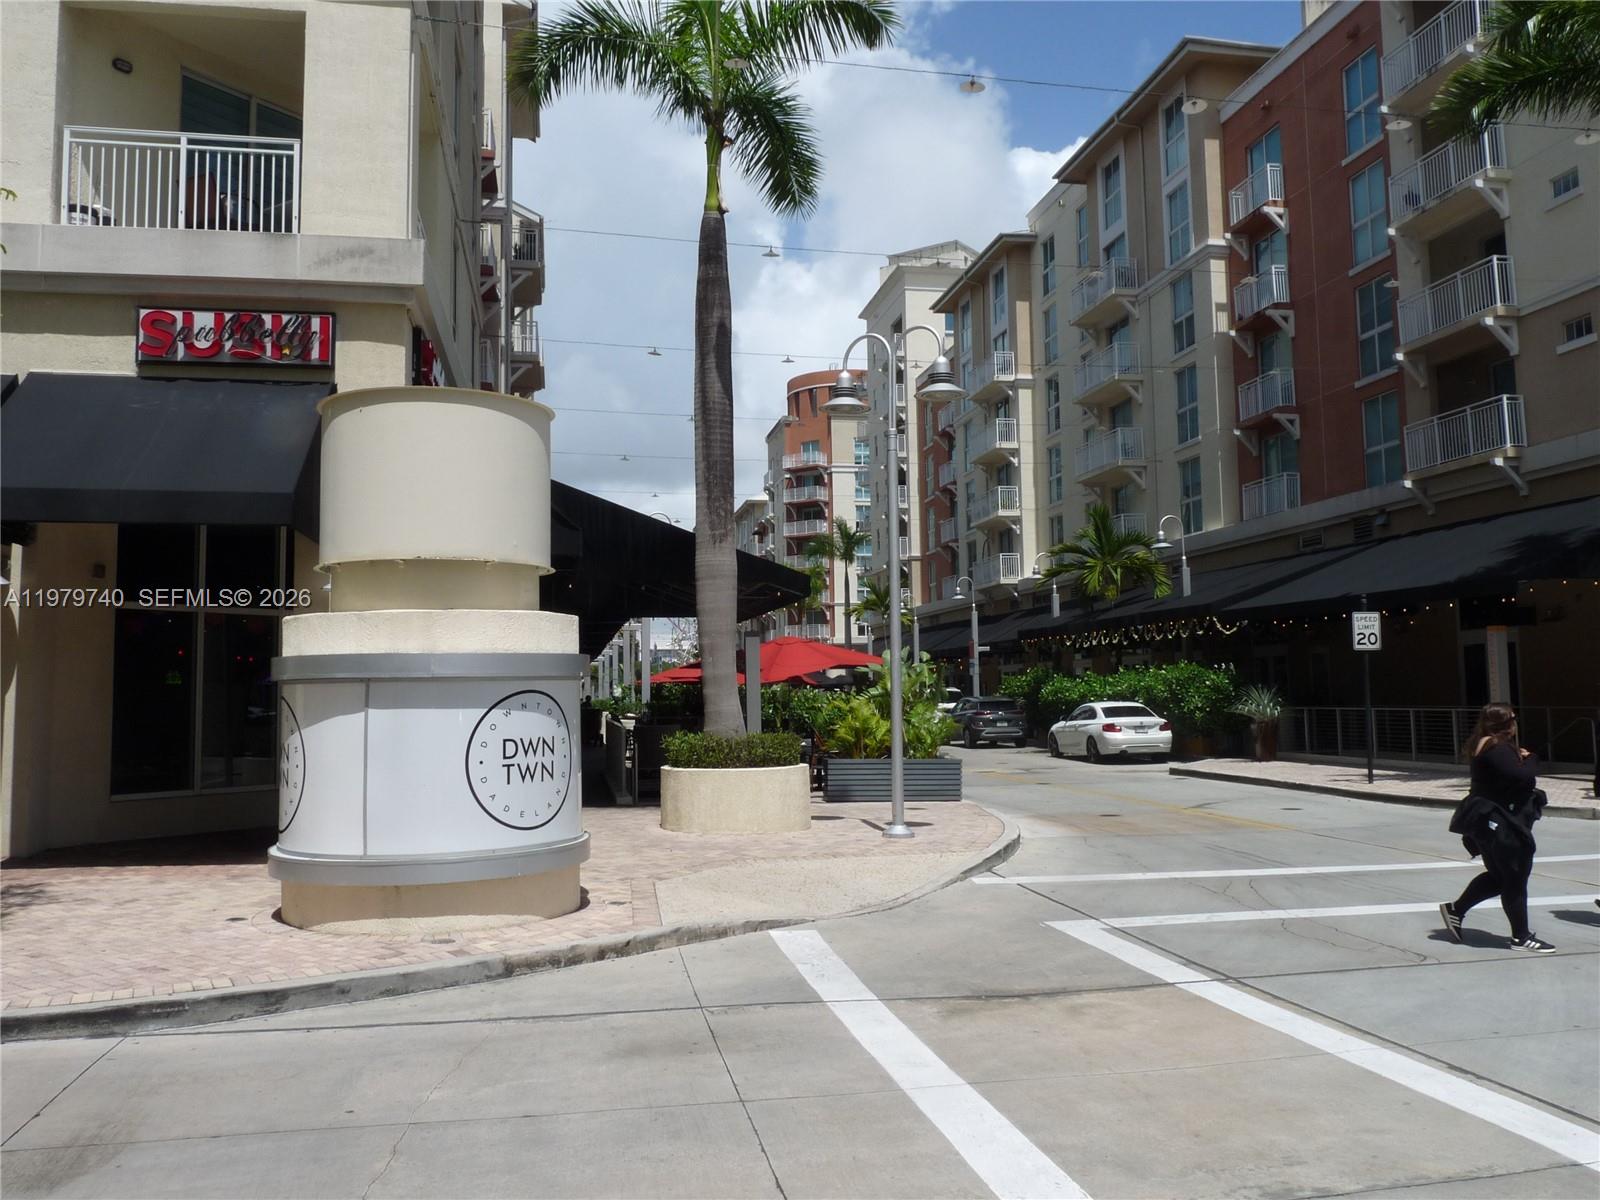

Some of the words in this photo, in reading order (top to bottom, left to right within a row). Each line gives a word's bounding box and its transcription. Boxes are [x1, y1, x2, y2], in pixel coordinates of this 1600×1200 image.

[139, 310, 330, 361] SUSHI
[1356, 632, 1378, 646] 20
[502, 735, 555, 760] DWN
[502, 760, 554, 785] TWN
